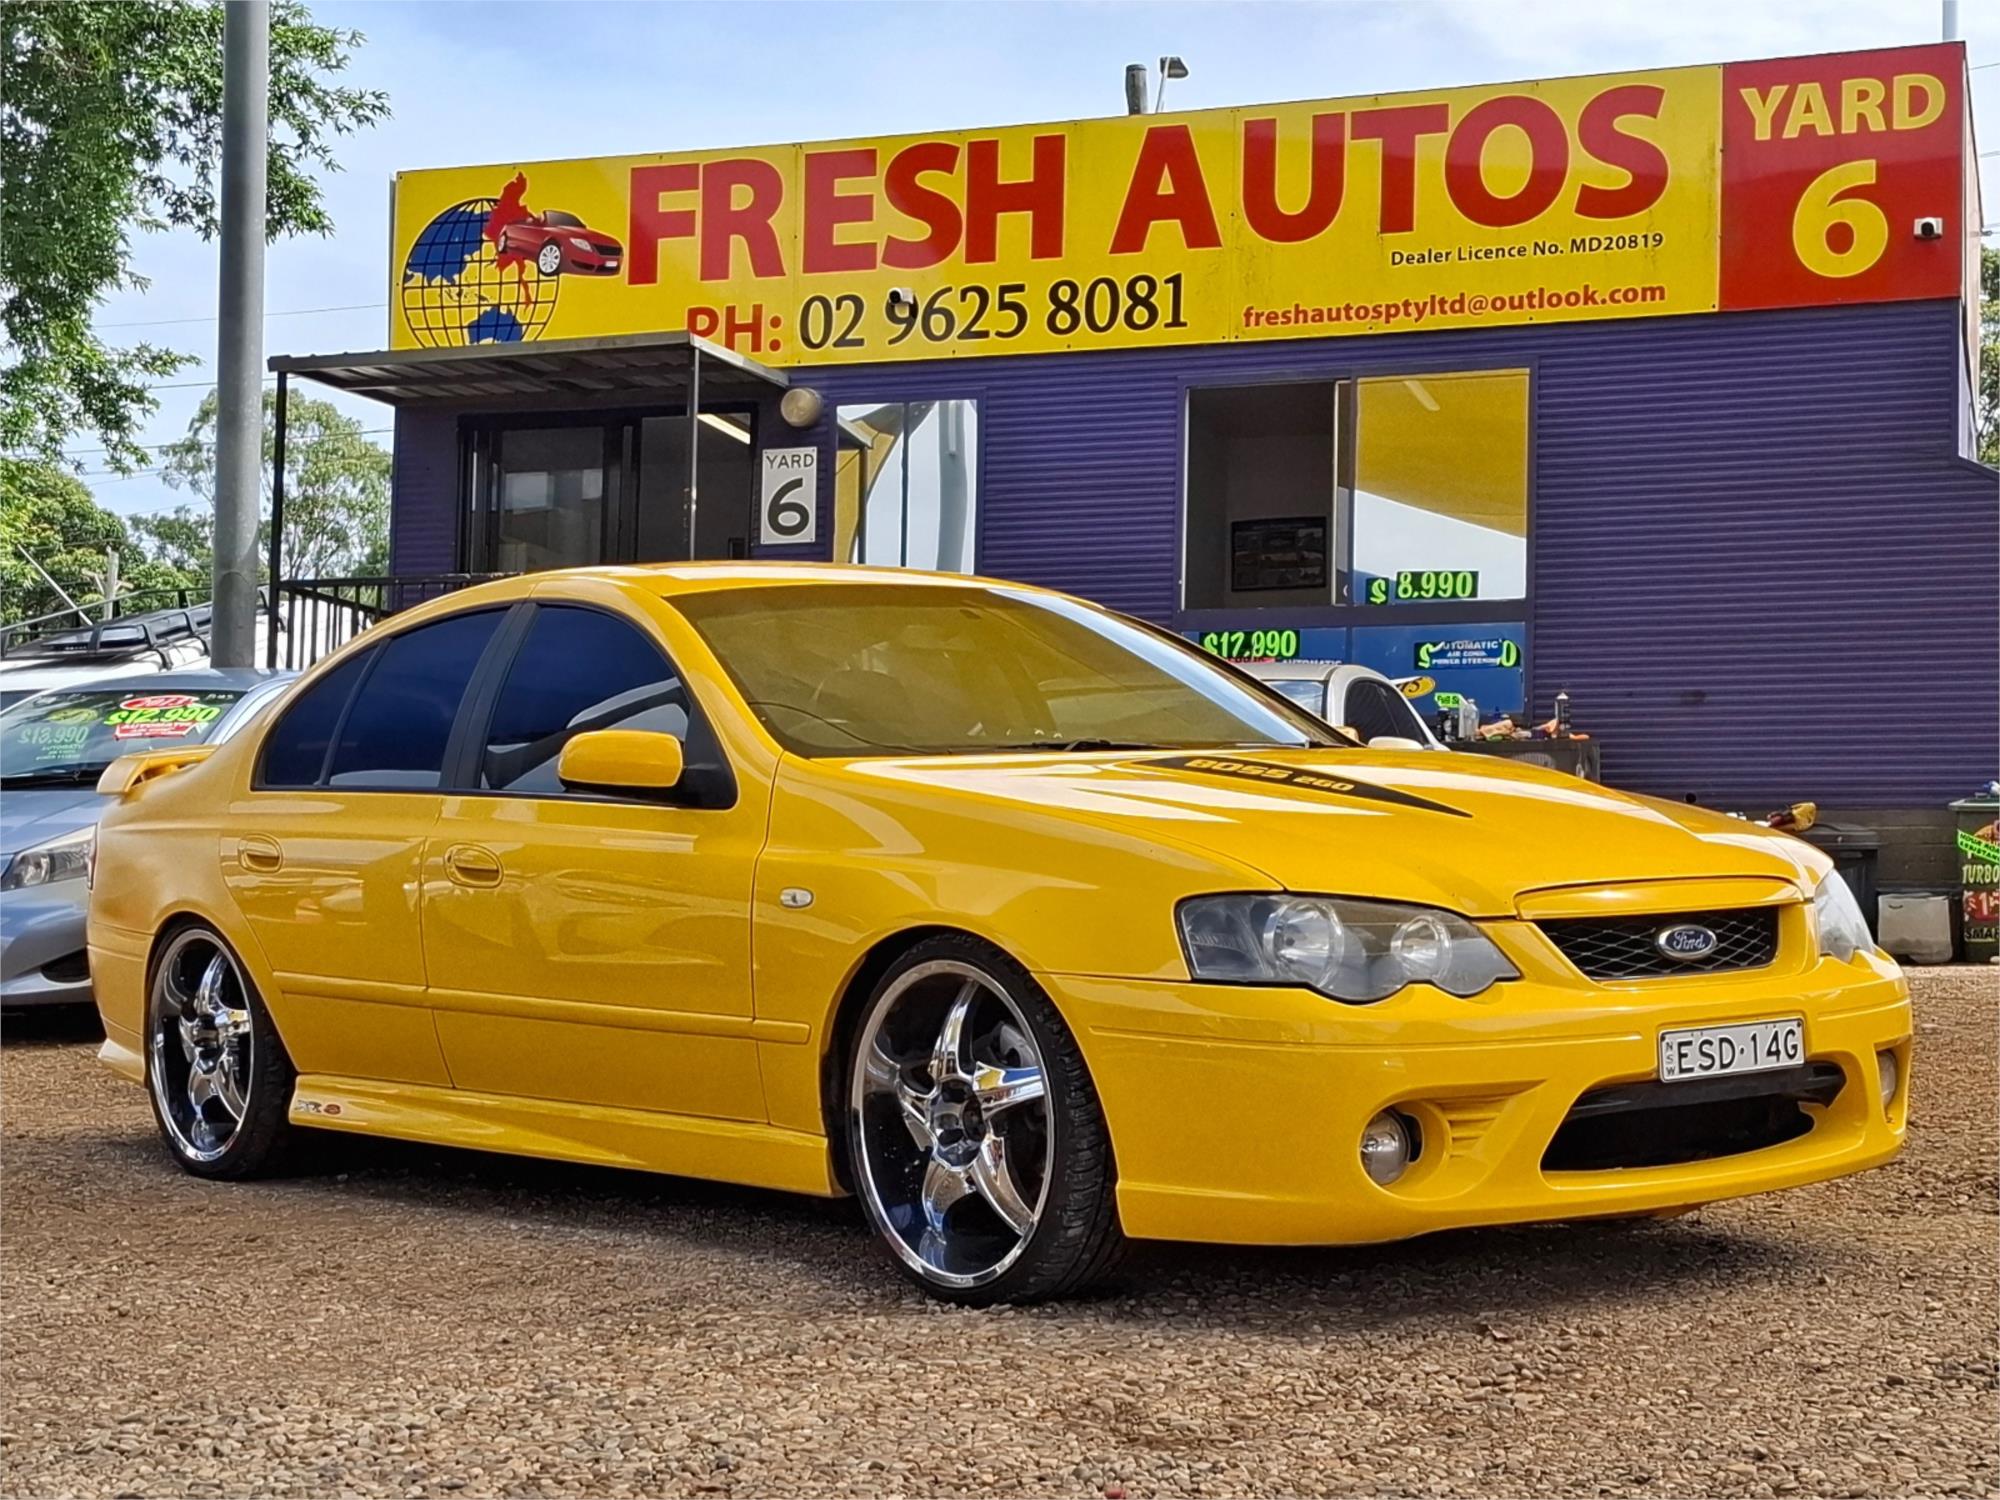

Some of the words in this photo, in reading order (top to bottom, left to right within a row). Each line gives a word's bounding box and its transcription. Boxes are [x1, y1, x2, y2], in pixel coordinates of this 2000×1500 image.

[1740, 73, 1946, 141] YARD
[628, 134, 1067, 285] FRESH
[1109, 85, 1669, 255] AUTOS
[1792, 159, 1889, 279] 6
[1391, 248, 1452, 267] Dealer
[1457, 242, 1527, 263] Licence
[1532, 238, 1564, 258] No.
[1570, 231, 1664, 255] MD20819
[687, 303, 782, 353] PH:
[799, 294, 865, 350] 02
[886, 281, 1029, 347] 9625
[1045, 271, 1187, 336] 8081
[1243, 282, 1667, 329] freshautosptyltd@outlook.com
[766, 453, 814, 469] YARD
[767, 477, 810, 537] 6
[1185, 759, 1294, 779] BOSS
[1673, 930, 1706, 950] Ford
